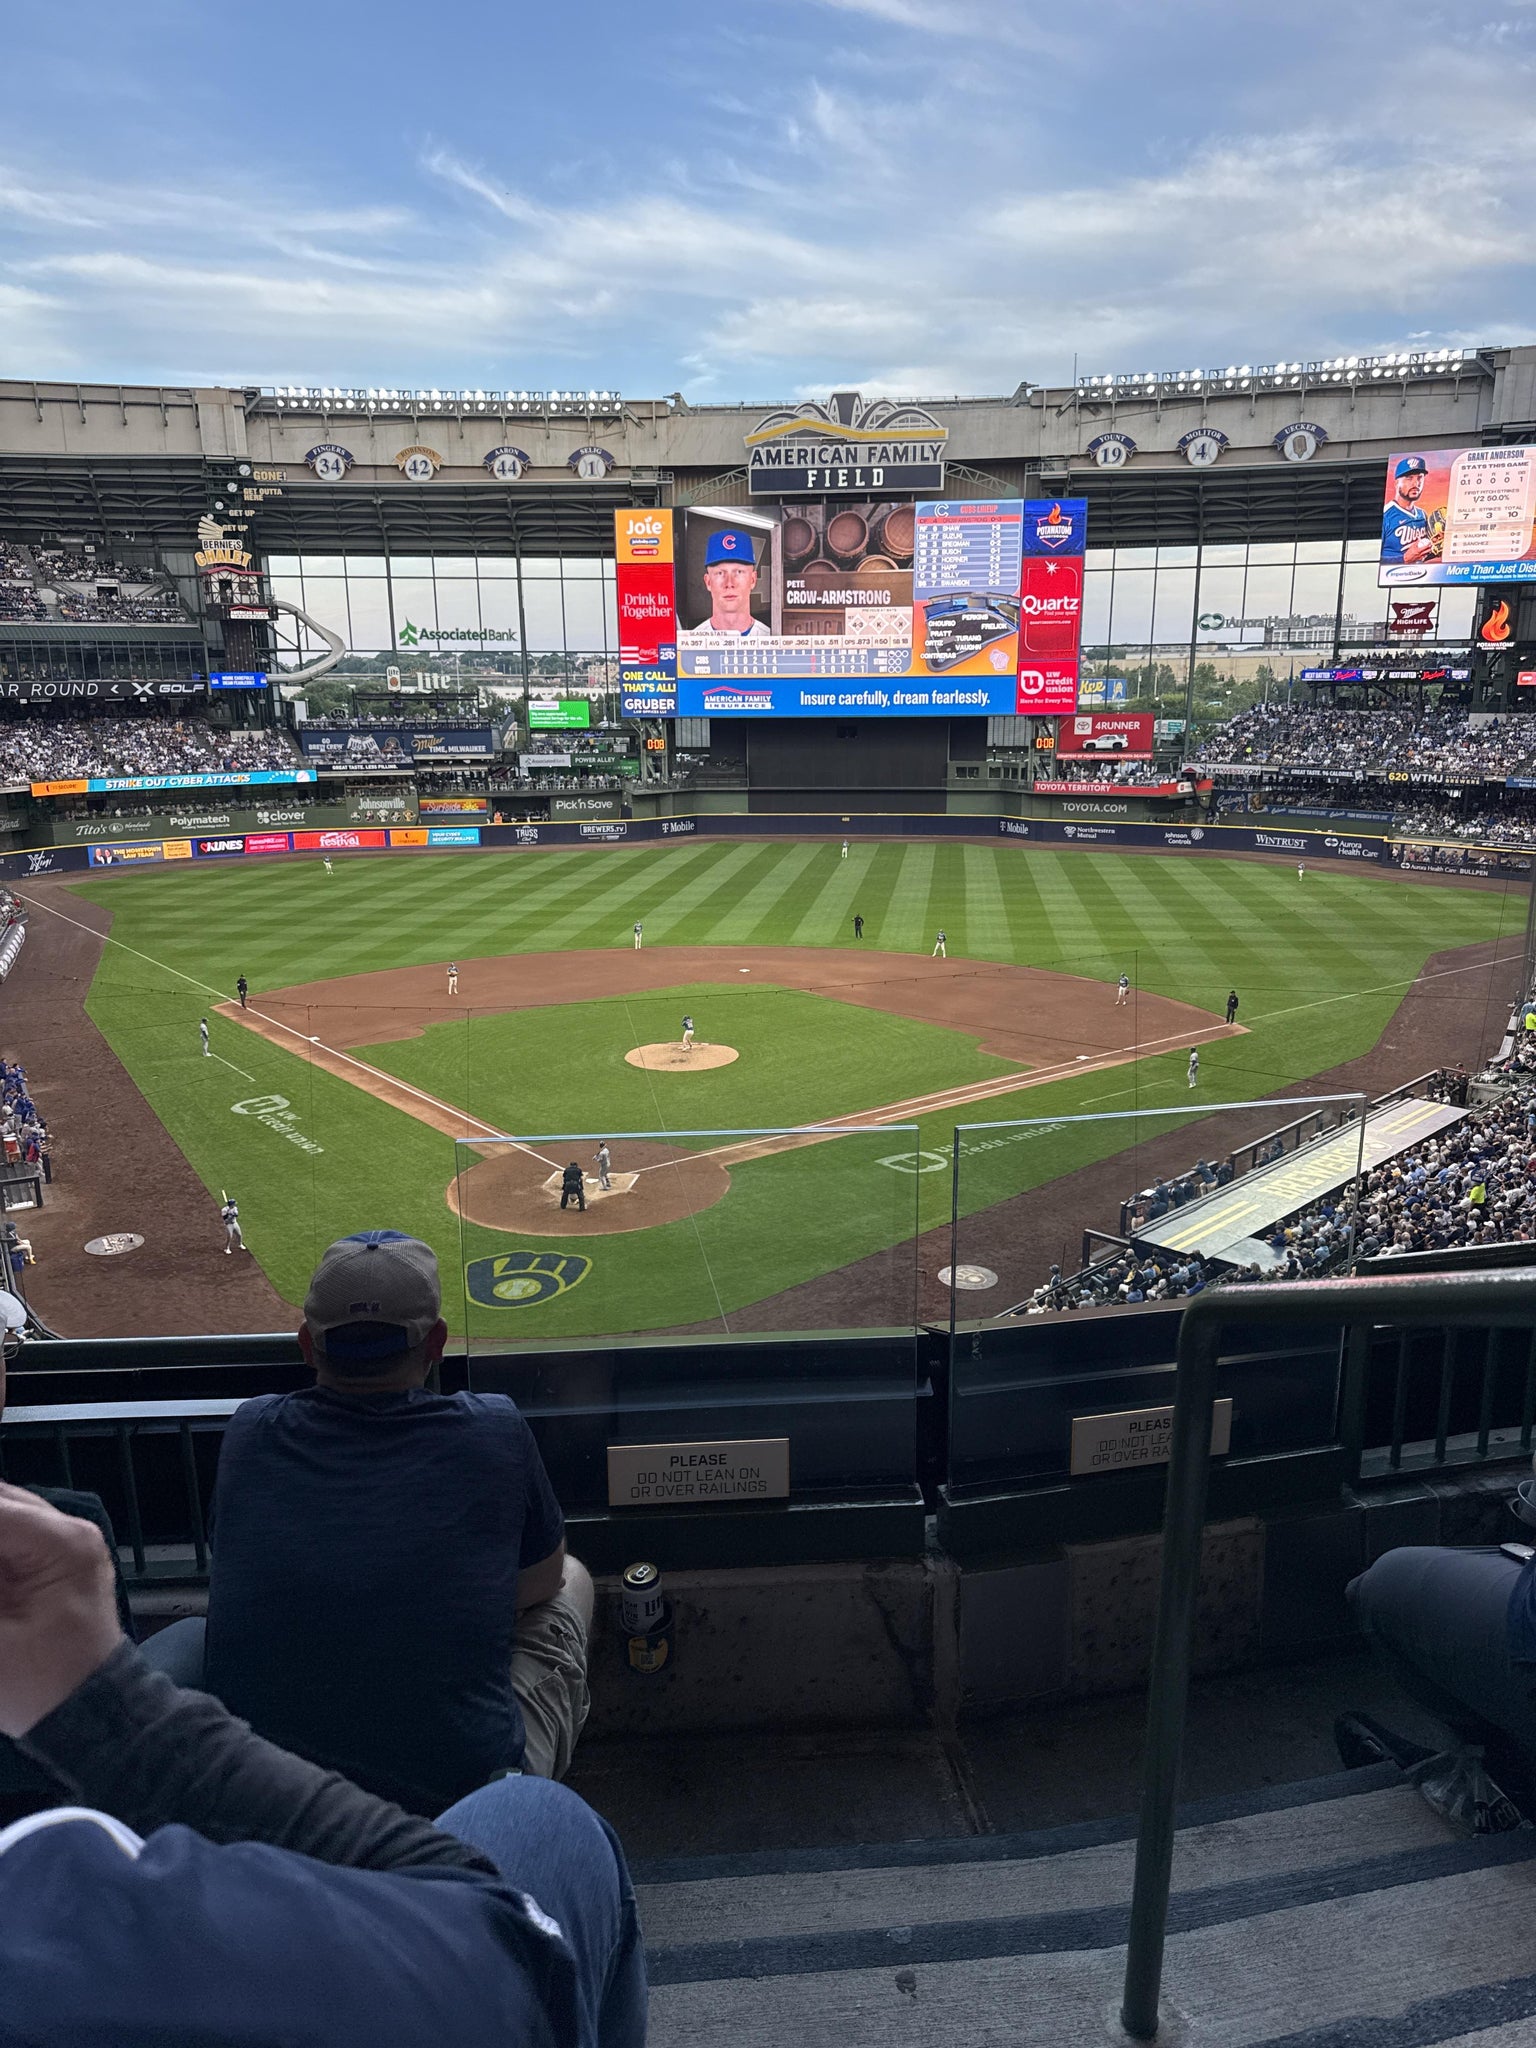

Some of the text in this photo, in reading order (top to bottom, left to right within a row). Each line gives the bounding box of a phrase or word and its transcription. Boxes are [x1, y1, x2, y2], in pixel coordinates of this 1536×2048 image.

[1185, 429, 1222, 441] MOLITOR
[1285, 424, 1317, 436] UECKER
[1100, 434, 1126, 444] YOUNT
[313, 446, 345, 456] FINGERS
[400, 447, 436, 458] ROBINSON
[495, 448, 519, 456] AARON
[751, 444, 942, 466] AMERICAN FAMILY
[1100, 447, 1122, 464] 19
[1196, 442, 1207, 458] 4
[1468, 450, 1524, 461] GRANT ANDERSON
[320, 458, 341, 474] 34
[409, 460, 429, 476] 42
[497, 460, 518, 476] 44
[588, 462, 596, 477] 1
[253, 471, 287, 481] GONE!
[807, 468, 884, 488] FIELD
[243, 488, 282, 496] GET OUTTA
[961, 505, 976, 513] CUBS
[222, 524, 236, 532] GET
[626, 516, 662, 534] Joie
[202, 540, 242, 550] BERNIE'S
[194, 550, 252, 566] CHALET
[1447, 565, 1469, 575] More
[1472, 565, 1494, 574] Than
[1496, 564, 1515, 573] Just
[787, 580, 805, 588] PETE
[787, 590, 890, 604] CROW-ARMSTRONG
[1022, 594, 1078, 615] Quartz
[621, 605, 672, 620] Together
[1400, 607, 1426, 618] Miller
[1226, 616, 1264, 628] Aurora
[1268, 613, 1304, 627] Health
[1307, 615, 1337, 627] Care
[660, 651, 675, 660] 250
[623, 672, 675, 680] ONE CALL...
[1046, 677, 1074, 685] credit
[132, 682, 204, 695] X GOLF
[416, 672, 451, 694] Lite
[623, 683, 676, 692] THAT'S ALL!
[800, 689, 990, 707] Insure carefully, dream fearlessly.
[625, 699, 675, 710] GRUBER
[1095, 721, 1140, 730] 4RUNNER
[411, 737, 445, 752] Miller
[106, 774, 250, 789] STRIKE OUT CYBER ATTACKS
[1388, 772, 1443, 783] 620 WTMJ
[1036, 783, 1111, 792] TOYOTA TERRITORY
[358, 798, 406, 810] Johnsonville
[426, 802, 461, 812] Surfside
[556, 800, 578, 810] Pick
[588, 800, 613, 809] Save
[1062, 802, 1128, 813] TOYOTA.COM
[170, 814, 230, 826] Polymatech
[270, 811, 305, 822] clover
[516, 828, 538, 838] TRUSS
[1077, 826, 1115, 834] Northwestern
[1164, 832, 1188, 840] Johnson
[206, 840, 244, 852] KUNES
[320, 834, 360, 847] festival
[1256, 834, 1306, 848] WINTRUST
[1338, 840, 1362, 849] Aurora
[1338, 848, 1379, 858] Health Care
[1427, 864, 1444, 872] Health
[1460, 869, 1488, 877] BULLPEN
[257, 1114, 324, 1154] credit union
[1007, 1123, 1066, 1141] union
[1129, 1418, 1173, 1433] PLEAS
[1100, 1440, 1117, 1451] DO
[1122, 1436, 1147, 1449] NOT
[1151, 1432, 1173, 1445] LEA
[670, 1454, 727, 1467] PLEASE
[1092, 1448, 1148, 1466] OR OVER
[637, 1467, 760, 1484] DO NOT LEAN ON
[631, 1481, 767, 1498] OR OVER RAILINGS
